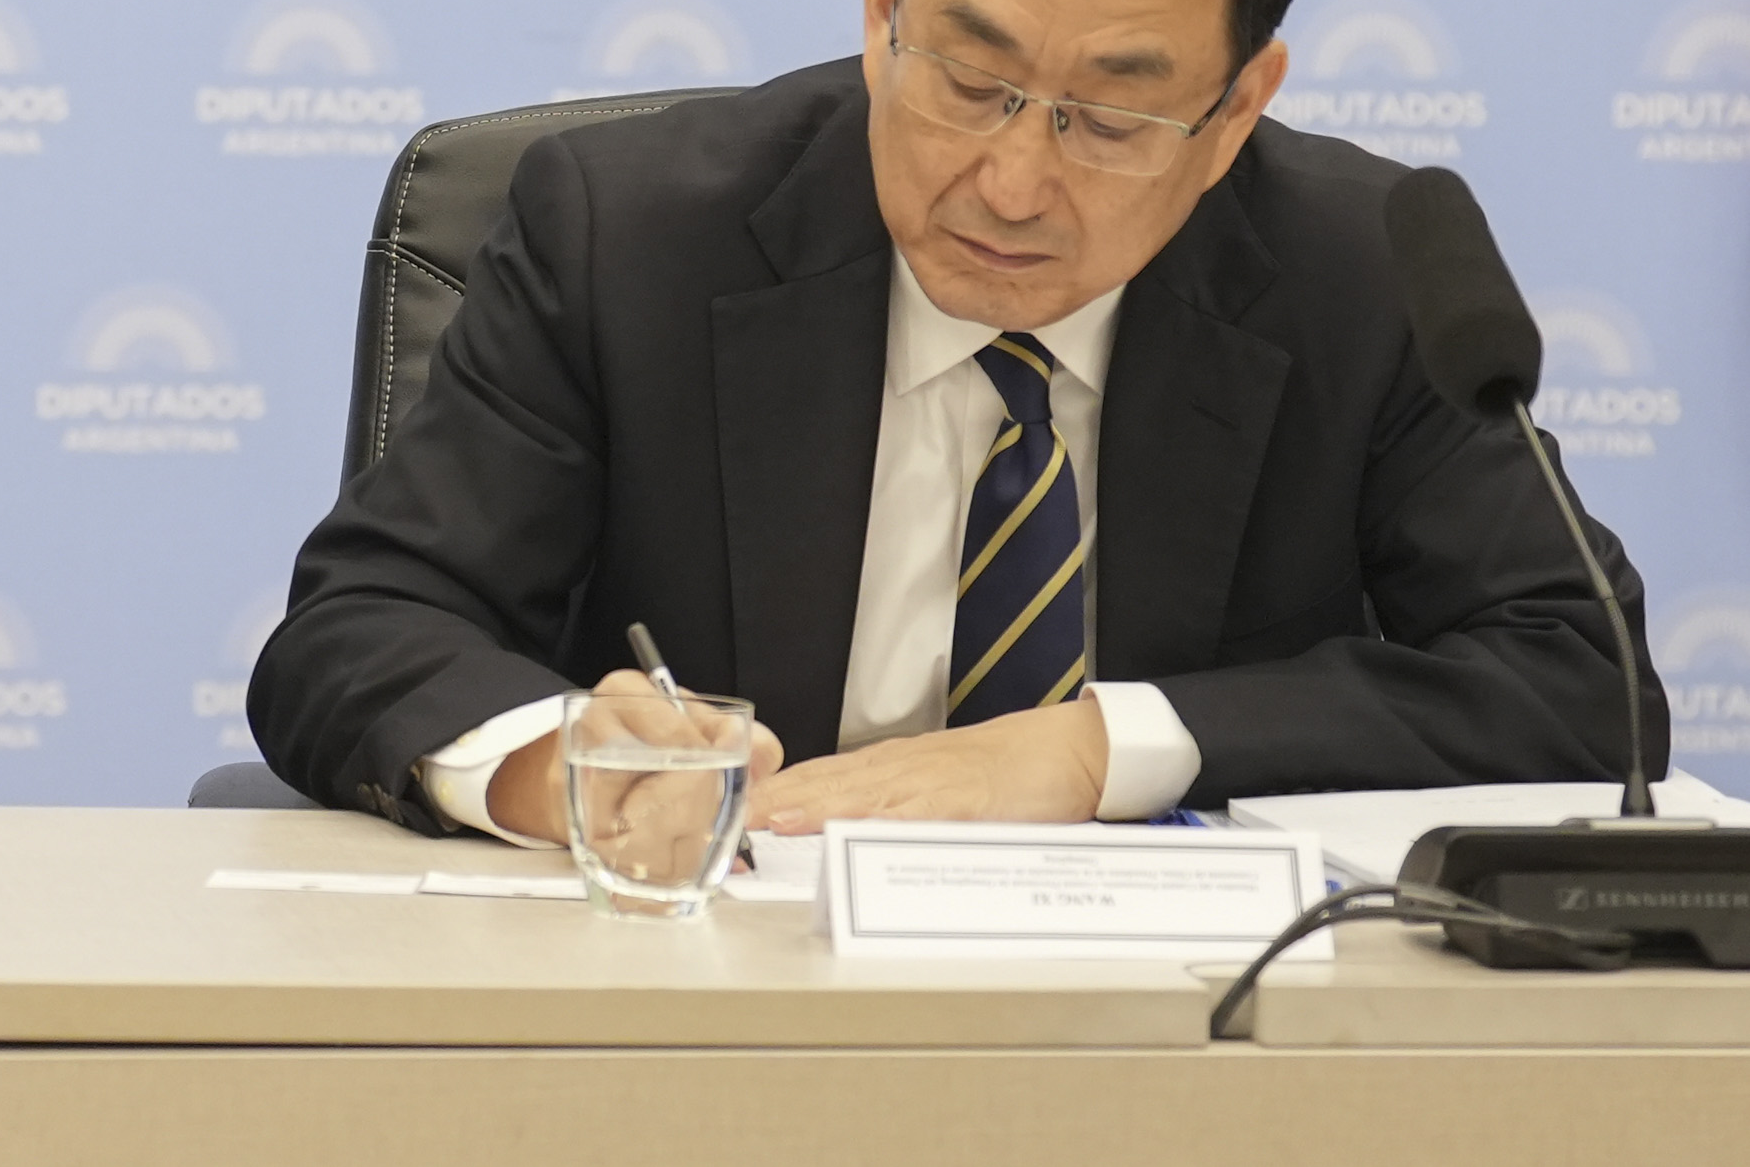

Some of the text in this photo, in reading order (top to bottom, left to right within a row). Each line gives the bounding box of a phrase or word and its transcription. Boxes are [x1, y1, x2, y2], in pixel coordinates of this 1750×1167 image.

[196, 88, 423, 124] DIPUTADOS
[1612, 91, 1750, 128] DIPUTA
[35, 384, 265, 420] DIPUTADOS
[1595, 890, 1750, 908] SENNHEISER
